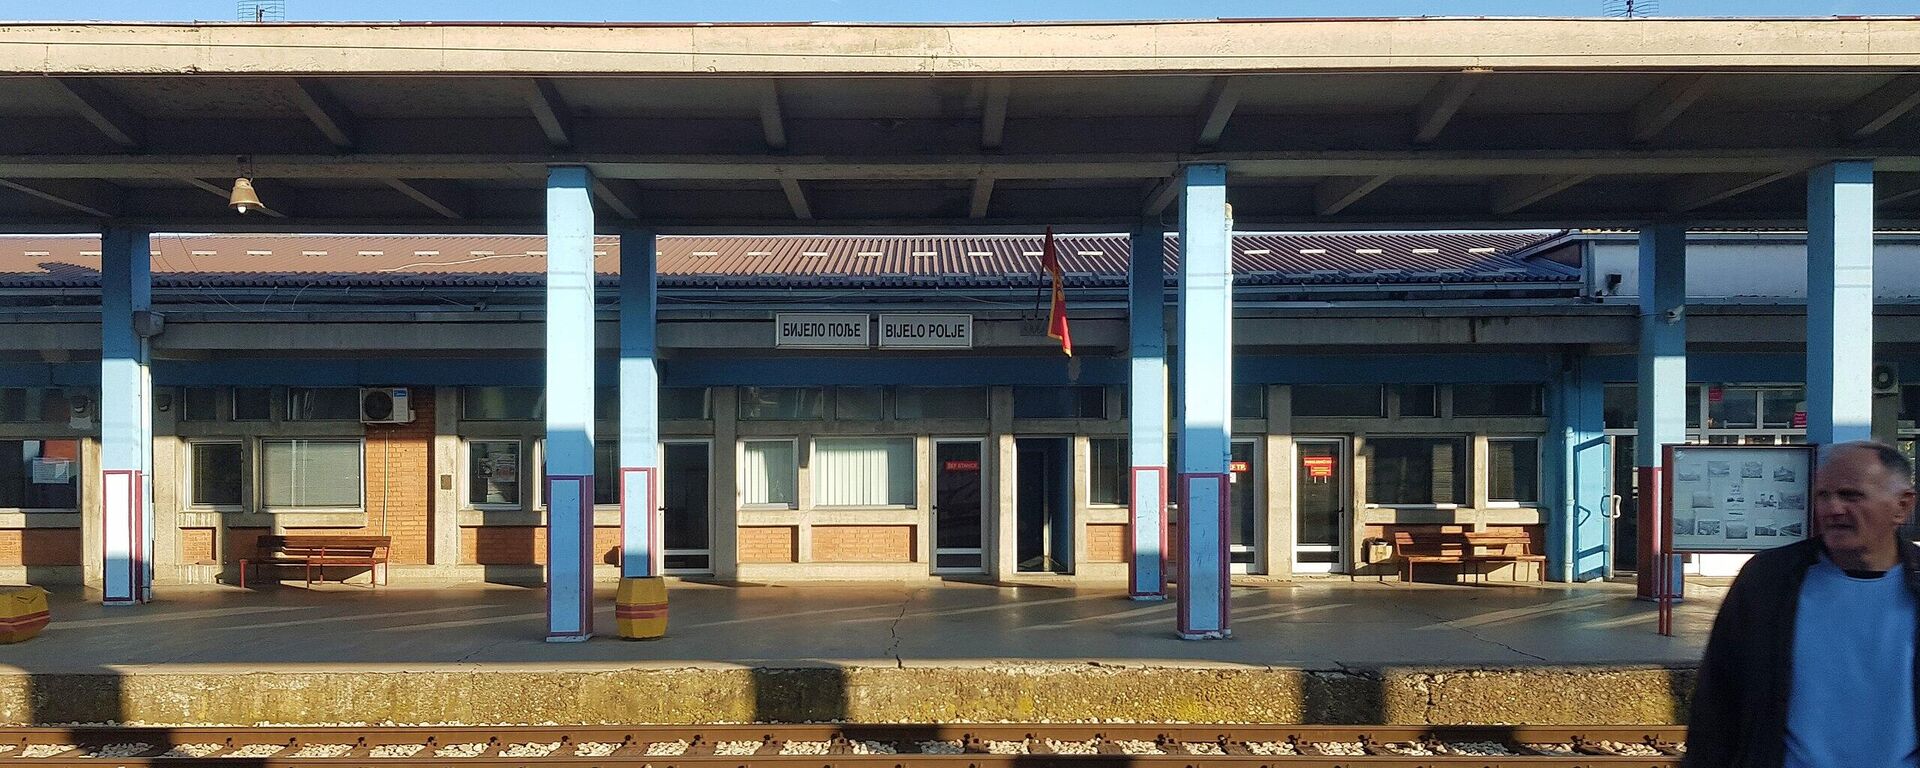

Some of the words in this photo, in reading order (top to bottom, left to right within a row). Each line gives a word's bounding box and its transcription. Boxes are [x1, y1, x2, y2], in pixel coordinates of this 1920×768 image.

[783, 322, 825, 337] БИЈЕЛО
[828, 322, 861, 337] ПОЉЕ
[885, 323, 925, 338] BIJELO
[928, 323, 965, 338] POLJE
